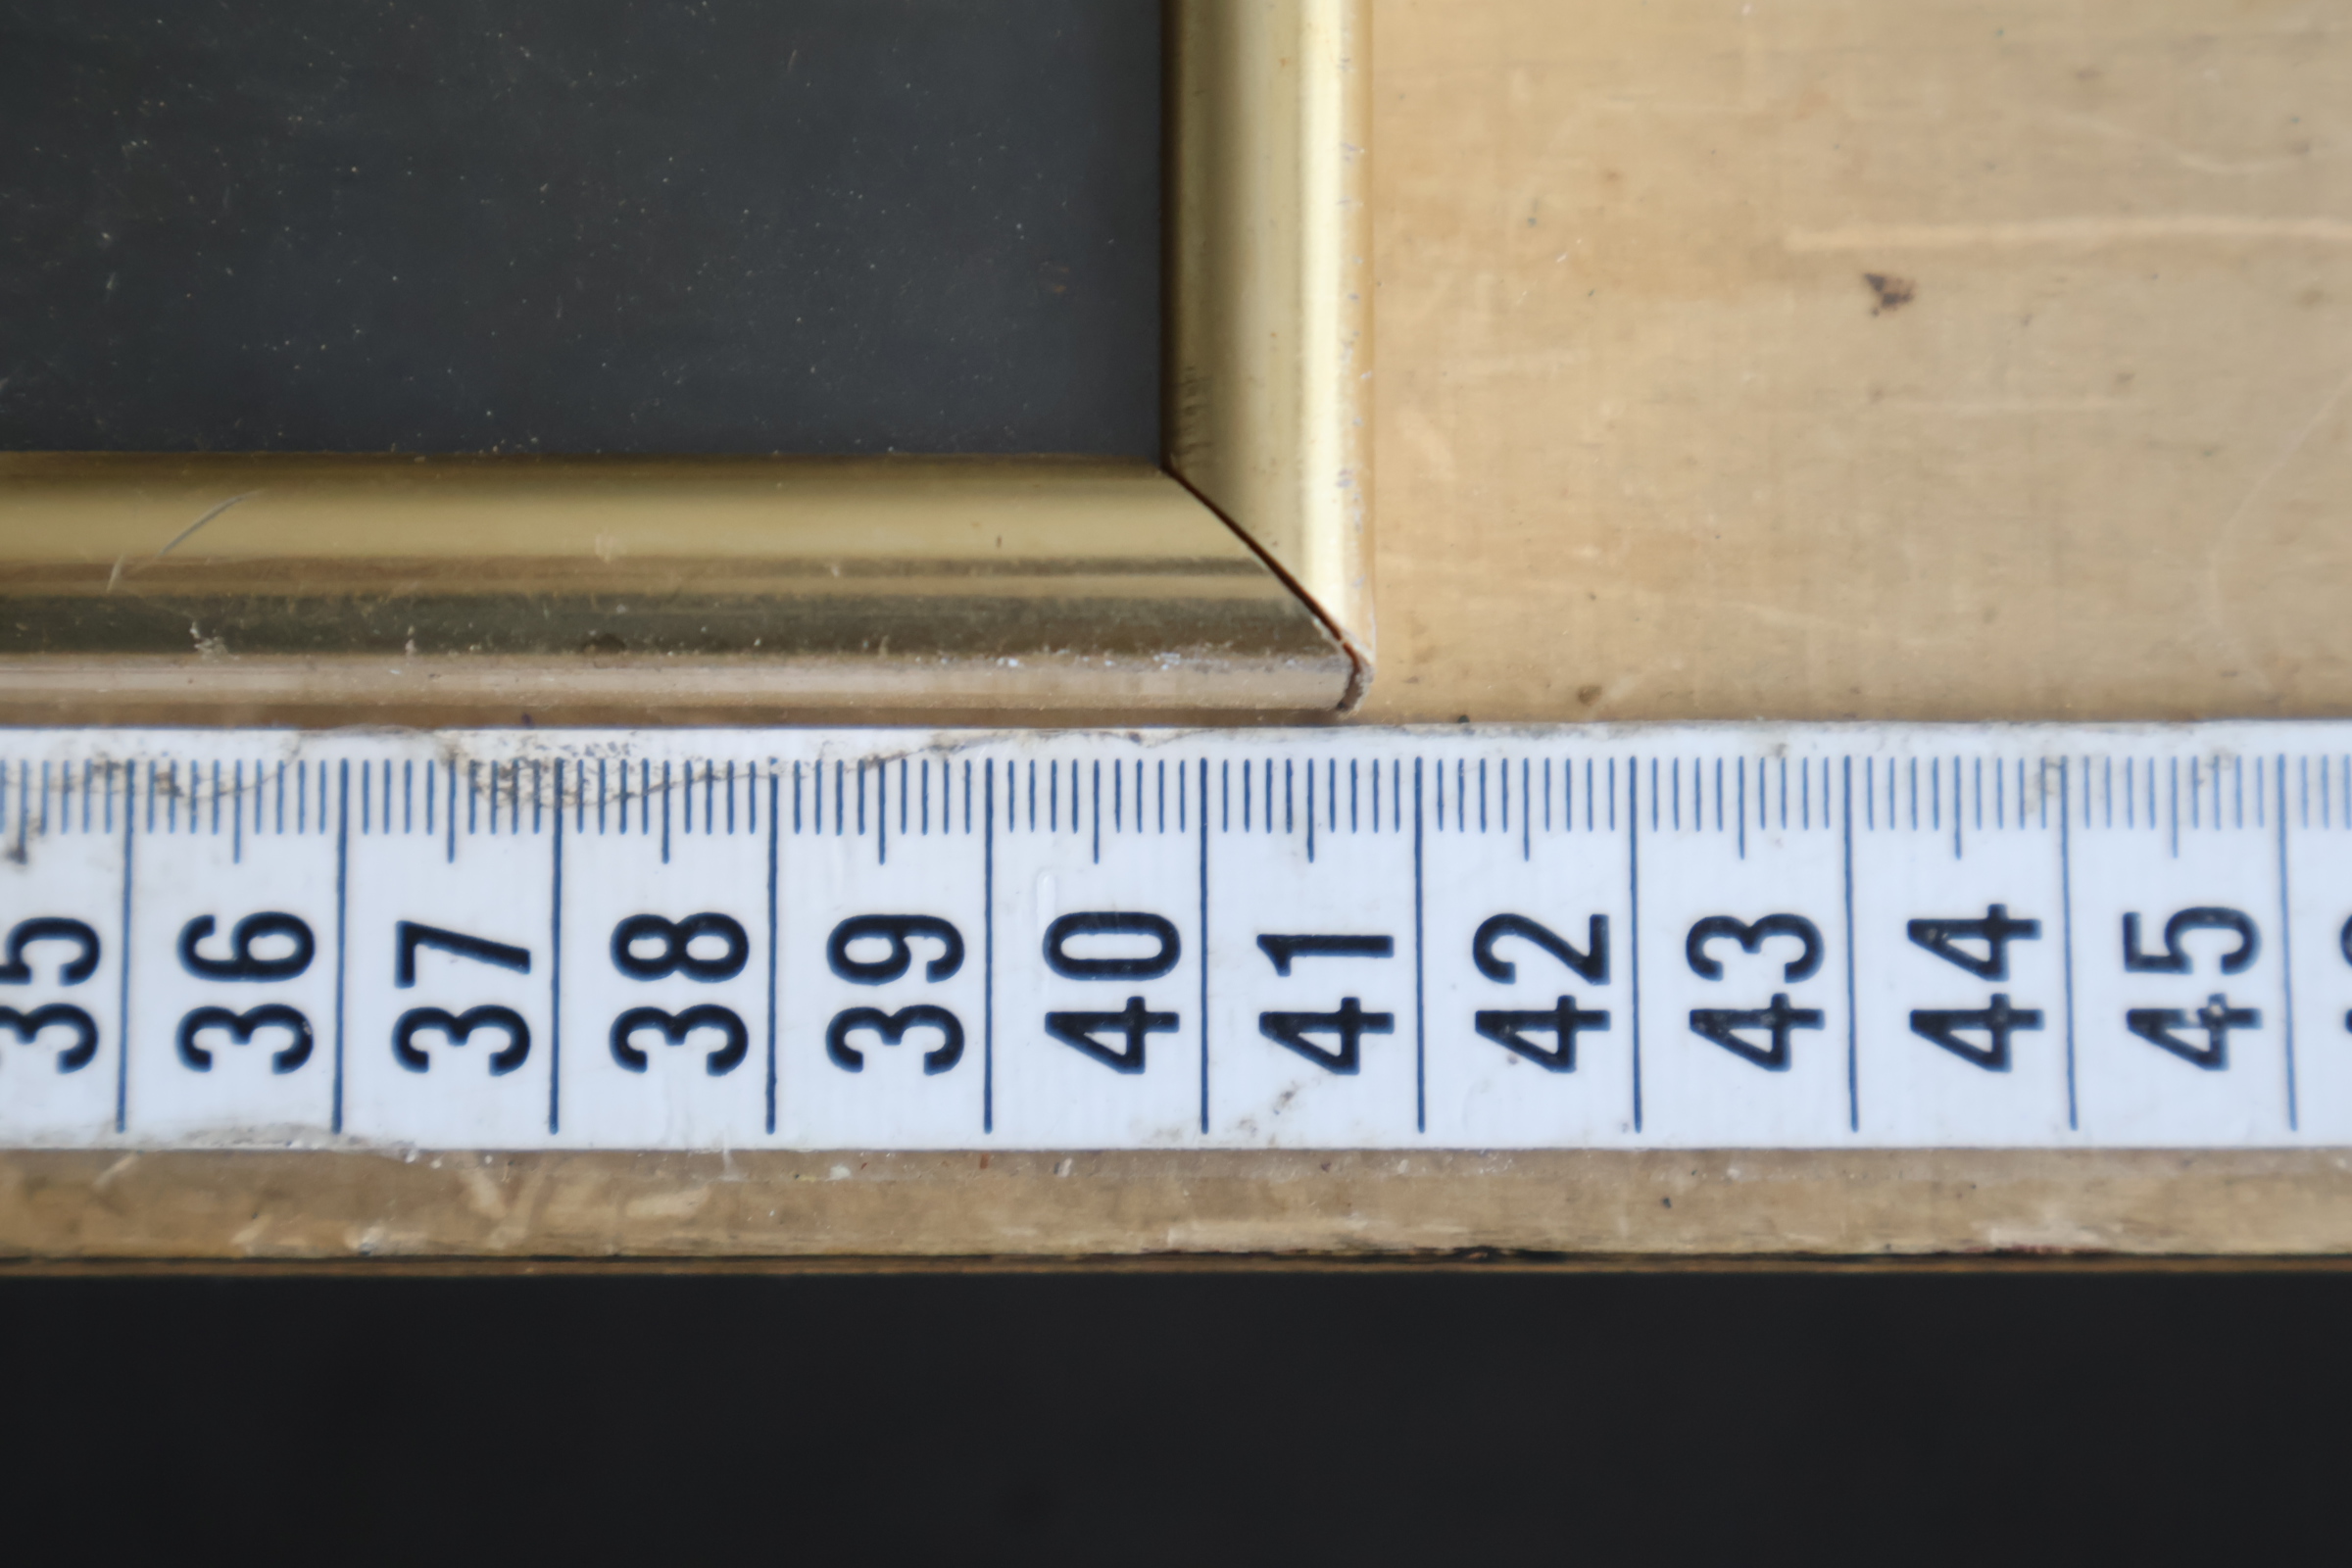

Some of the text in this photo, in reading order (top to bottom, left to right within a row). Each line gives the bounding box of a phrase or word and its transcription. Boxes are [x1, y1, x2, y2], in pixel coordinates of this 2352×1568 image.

[0, 915, 101, 1074] 35
[176, 910, 316, 1074] 36
[392, 919, 532, 1076] 37
[609, 911, 750, 1076] 38
[825, 913, 966, 1076] 39
[1042, 910, 1182, 1075] 40
[1256, 933, 1395, 1075] 41
[1471, 911, 1610, 1073] 42
[1685, 912, 1825, 1072] 43
[1906, 903, 2045, 1073] 44
[2121, 906, 2263, 1072] 45
